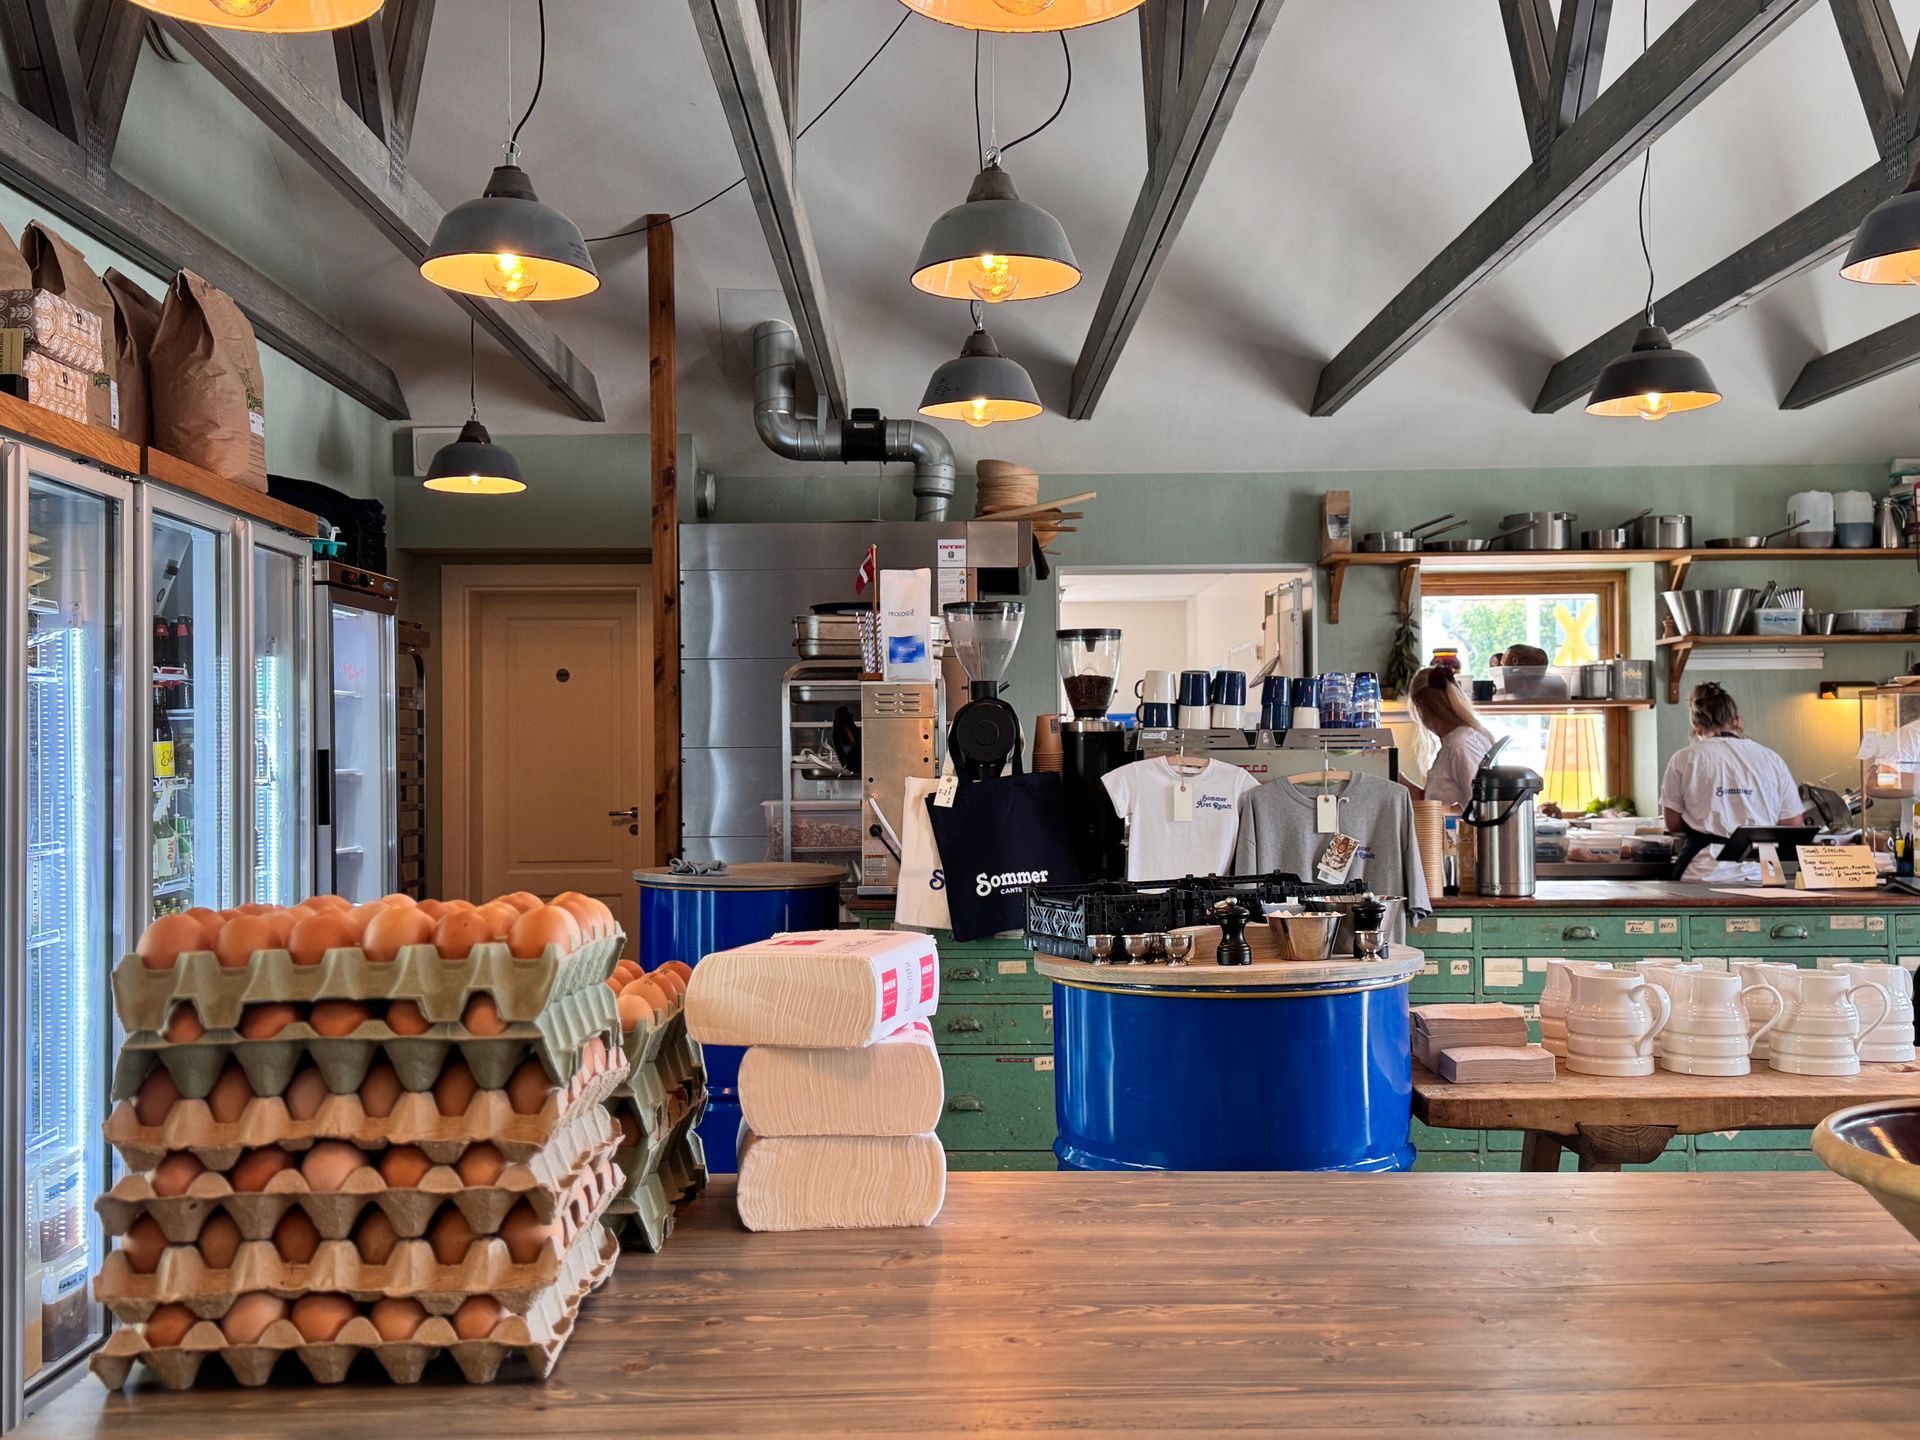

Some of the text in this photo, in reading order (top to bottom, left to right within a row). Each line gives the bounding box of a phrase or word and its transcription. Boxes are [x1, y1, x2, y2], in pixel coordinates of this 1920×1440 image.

[1715, 786, 1753, 798] Sommer
[1201, 794, 1228, 803] Sommer
[976, 870, 1049, 897] Sommer
